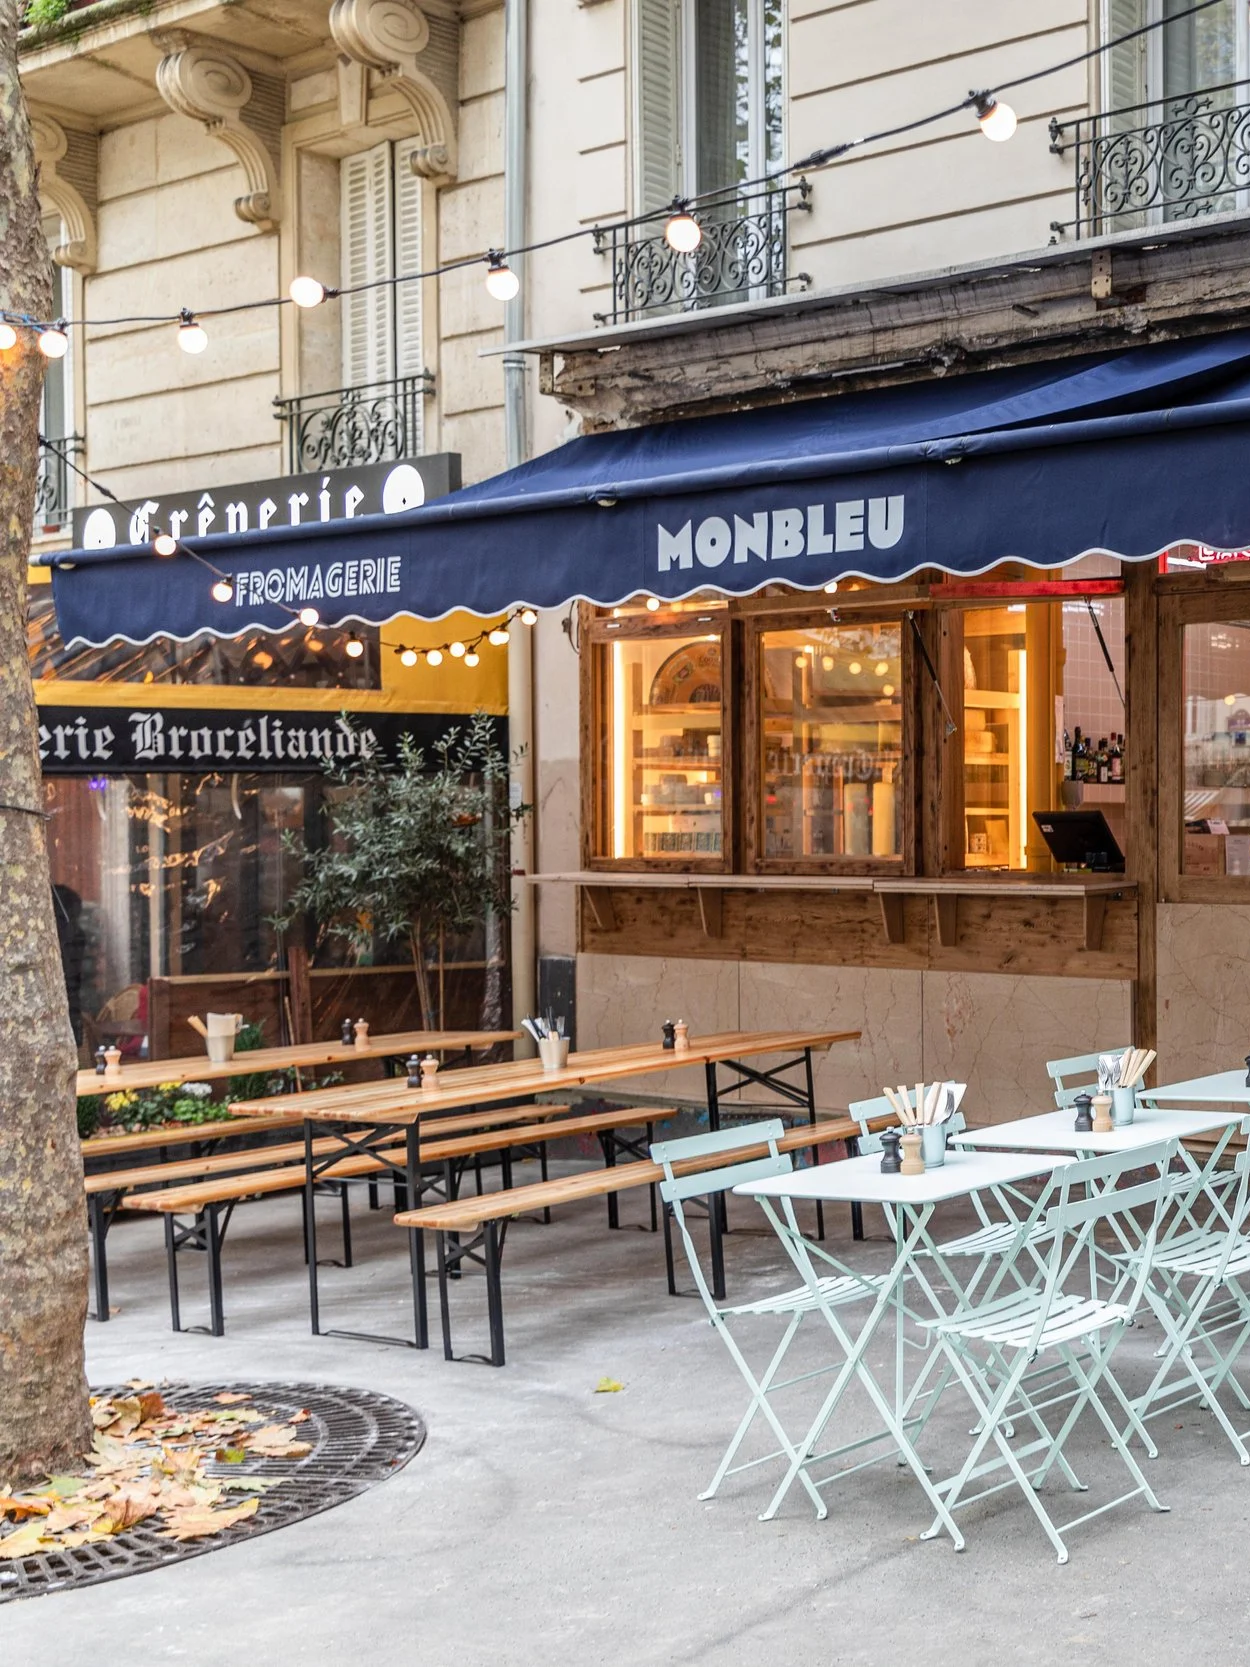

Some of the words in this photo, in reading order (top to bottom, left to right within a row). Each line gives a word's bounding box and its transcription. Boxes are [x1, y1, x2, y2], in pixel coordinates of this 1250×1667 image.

[657, 494, 905, 573] MONBLEU
[235, 556, 402, 607] FROMAGERIE
[127, 711, 377, 761] Brocéliande
